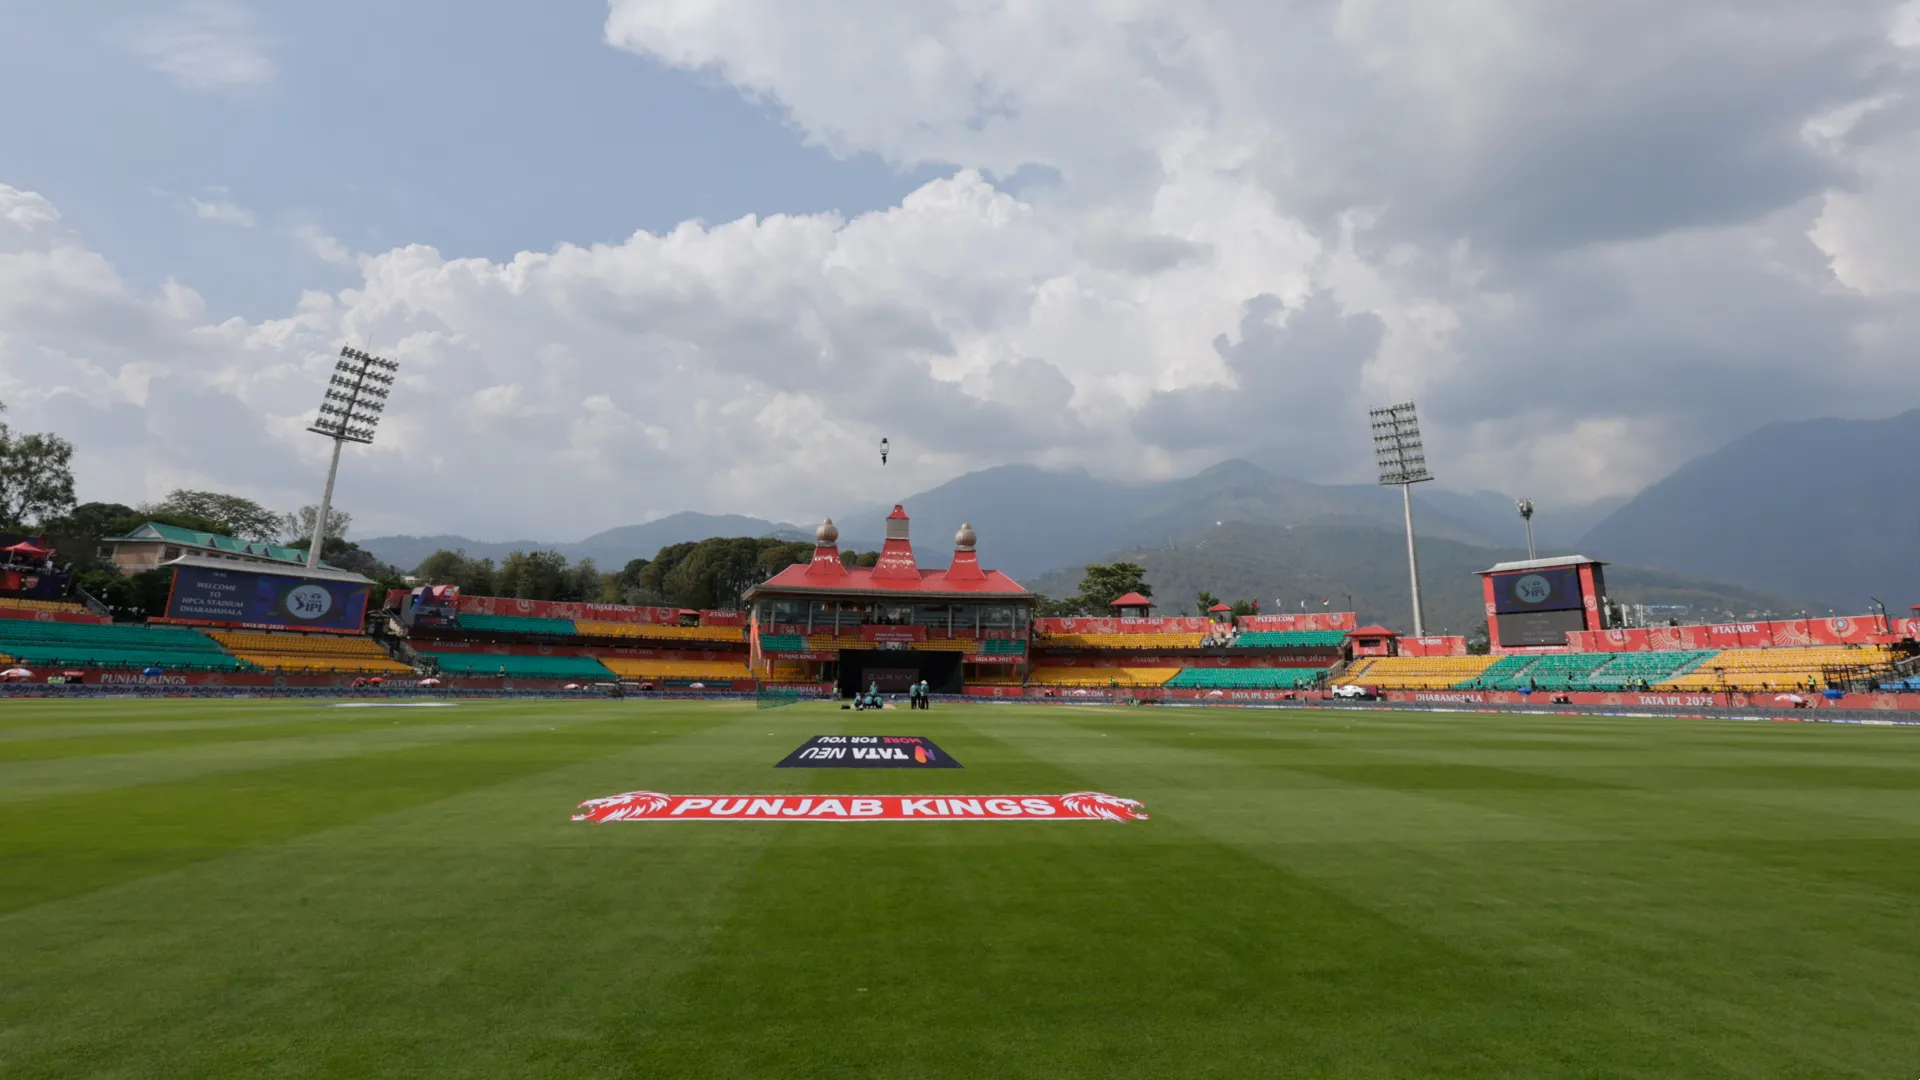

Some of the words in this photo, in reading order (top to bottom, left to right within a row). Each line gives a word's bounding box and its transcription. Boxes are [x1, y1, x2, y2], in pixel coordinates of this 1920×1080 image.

[197, 582, 237, 591] WELCOME
[1531, 589, 1547, 597] IPL
[207, 600, 244, 608] STADIUM
[306, 604, 324, 612] IPL
[586, 603, 613, 612] PUNJAB
[614, 604, 636, 613] KINGS
[180, 606, 243, 616] DHARAMSHALA
[1712, 624, 1759, 634] #TATAIPL
[100, 673, 145, 684] PUNJAB
[1638, 696, 1665, 705] TATA
[1667, 696, 1682, 705] IPL
[1684, 696, 1713, 706] 2025
[799, 747, 847, 759] NEU
[852, 747, 909, 759] TATA
[670, 798, 883, 816] PUNJAB
[901, 798, 1055, 816] KINGS
